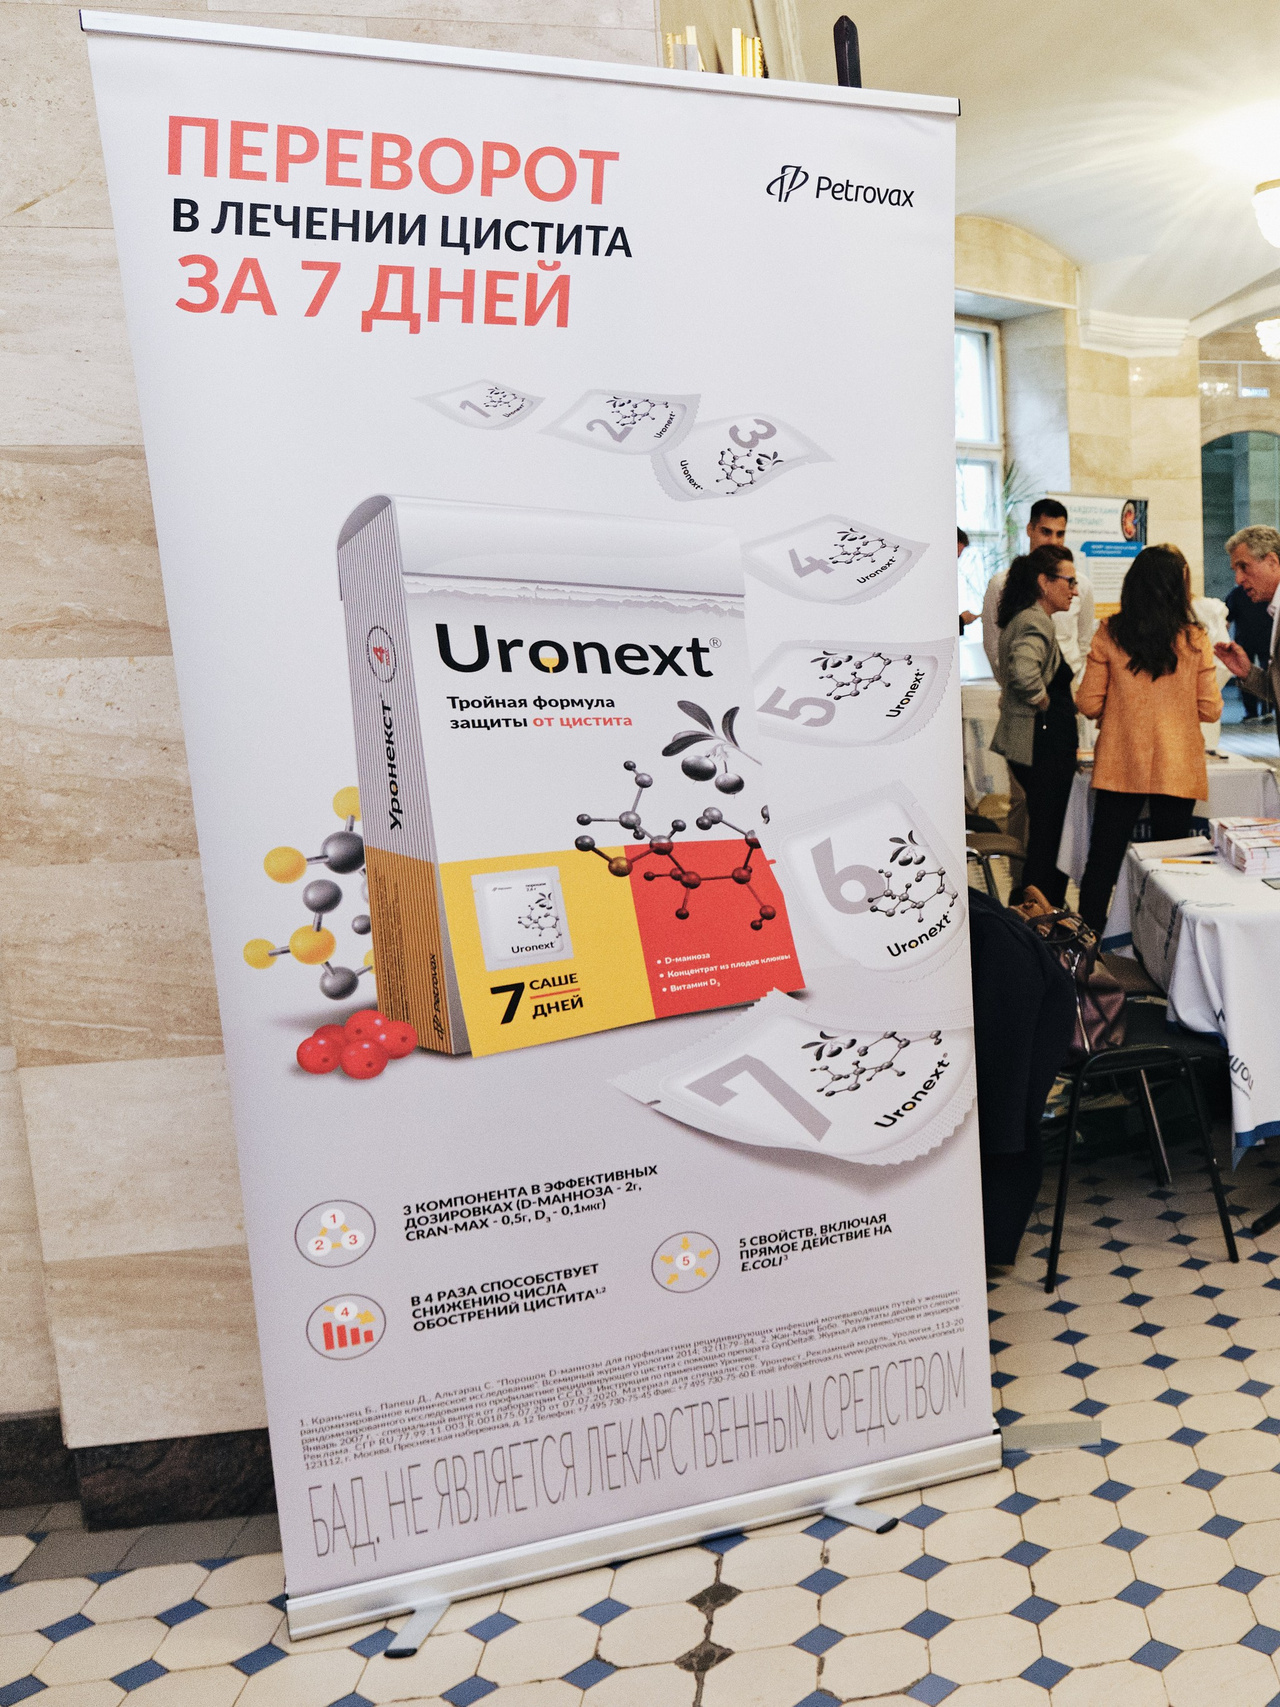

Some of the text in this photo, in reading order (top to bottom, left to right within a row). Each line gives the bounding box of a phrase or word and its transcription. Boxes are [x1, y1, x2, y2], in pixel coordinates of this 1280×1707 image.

[166, 115, 620, 205] ПЕРЕВОРОТ
[814, 175, 916, 209] Petrovax
[171, 198, 633, 259] В ЛЕЧЕНИИ ЦИСТИТА
[175, 253, 572, 334] ЗА 7 ДНЕЙ
[729, 419, 777, 449] 3
[788, 548, 835, 578] 4
[447, 695, 615, 711] Тройная формула
[757, 686, 836, 727] 5
[450, 716, 633, 731] защиты от цистита
[381, 700, 403, 830] Уронекст
[811, 837, 886, 914] 6
[667, 963, 718, 978] Концентрат
[730, 958, 759, 969] плодов
[490, 973, 578, 1025] 7 САШЕ
[670, 979, 708, 992] Витамин
[532, 995, 584, 1019] ДНЕЙ
[402, 1165, 658, 1216] 3 КОМПОНЕНТА В ЭФФЕКТИВНЫХ
[404, 1200, 513, 1231] ДОЗИРОВКАХ
[516, 1184, 614, 1212] (D-МАННОЗА
[330, 1213, 338, 1225] 1
[405, 1218, 490, 1242] CRAN-MAX
[739, 1213, 887, 1248] 5 СВОЙСТВ, ВКЛЮЧАЯ
[314, 1235, 358, 1251] 2 3
[740, 1224, 892, 1260] ПРЯМОЕ ДЕЙСТВИЕ НА
[682, 1255, 690, 1266] 5
[410, 1263, 599, 1307] В 4 РАЗА СПОСОБСТВУЕТ
[411, 1282, 567, 1320] СНИЖЕНИЮ ЧИСЛА
[340, 1307, 350, 1318] 4
[413, 1302, 520, 1332] ОБОСТРЕНИЙ
[385, 1464, 428, 1539] НЕ
[434, 1432, 577, 1529] ЯВЛЯЕТСЯ
[587, 1381, 815, 1496] ЛЕКАРСТВЕННЫМ
[822, 1347, 966, 1446] СРЕДСТВОМ
